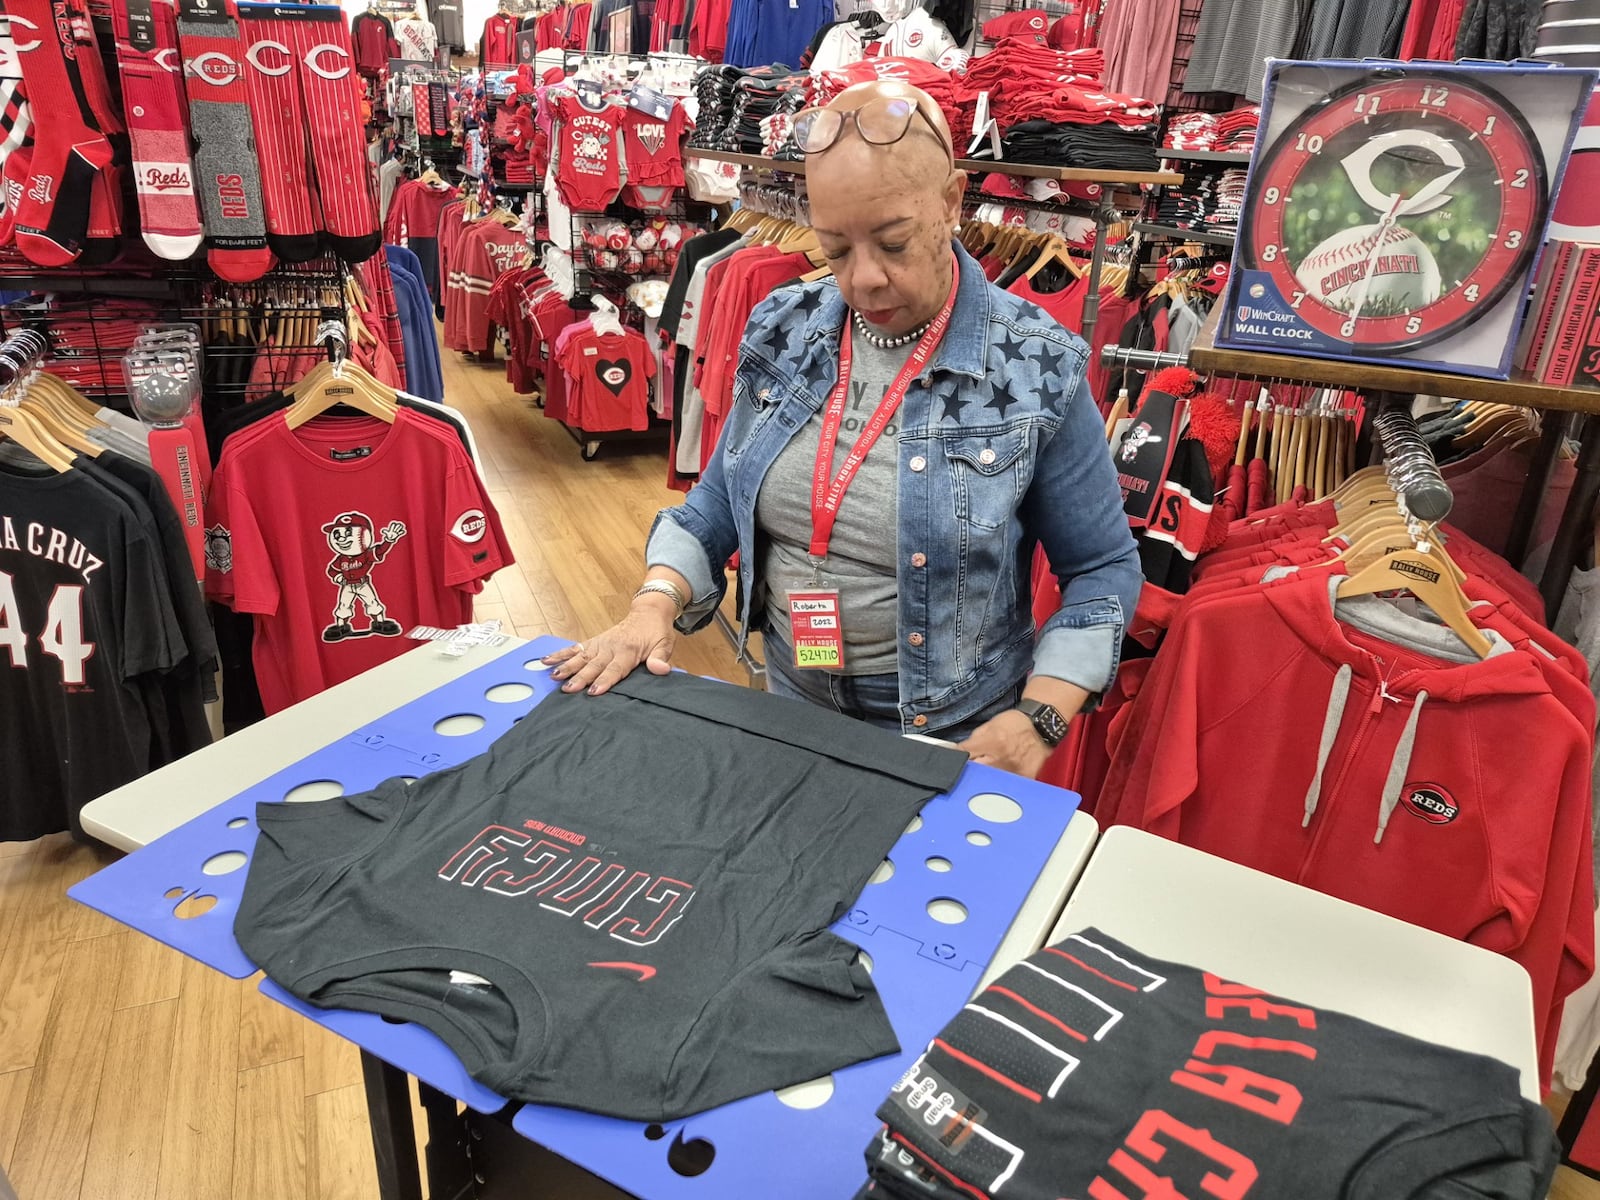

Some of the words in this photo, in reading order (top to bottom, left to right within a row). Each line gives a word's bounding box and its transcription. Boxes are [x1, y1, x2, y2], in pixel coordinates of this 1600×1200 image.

[204, 64, 236, 74] REDS
[1354, 93, 1381, 115] 11
[1419, 85, 1449, 107] 12
[573, 116, 612, 132] CUTEST
[637, 124, 665, 138] LOVE
[1482, 116, 1496, 136] 1
[1296, 132, 1323, 154] 10
[572, 157, 606, 172] Reds
[28, 174, 53, 205] Reds
[146, 167, 190, 192] Reds
[1511, 169, 1530, 188] 2
[216, 174, 249, 218] REDS
[1263, 187, 1280, 205] 9
[1504, 230, 1522, 249] 3
[1262, 244, 1278, 262] 8
[1584, 252, 1600, 278] PARK
[1290, 292, 1305, 309] 7
[1463, 283, 1480, 301] 4
[1576, 281, 1593, 303] BALL
[913, 334, 933, 363] RALLY
[931, 304, 952, 334] HOUSE
[1235, 323, 1269, 336] WALL
[1271, 328, 1314, 340] CLOCK
[1340, 320, 1355, 337] 6
[1405, 316, 1421, 334] 5
[1561, 303, 1586, 349] AMERICAN
[839, 359, 849, 385] RALLY
[1551, 353, 1569, 381] GREAT
[828, 387, 845, 416] HOUSE
[824, 421, 834, 439] YOUR
[860, 430, 875, 448] YOUR
[884, 392, 899, 411] YOUR
[176, 445, 194, 500] CINCINNATI
[818, 461, 827, 481] YOUR
[825, 484, 843, 511] RALLY
[838, 453, 862, 481] HOUSE
[184, 502, 198, 527] REDS
[462, 517, 486, 534] REDS
[0, 516, 21, 551] A
[27, 522, 105, 585] CRUZ
[341, 560, 363, 571] Reds
[1392, 561, 1413, 573] RALLY
[1414, 568, 1438, 582] HOUSE
[793, 601, 827, 610] Roberta
[799, 650, 839, 662] 524710
[1411, 792, 1456, 818] REDS
[437, 824, 696, 946] CINCY
[909, 1079, 935, 1107] Small
[926, 1094, 952, 1124] Small
